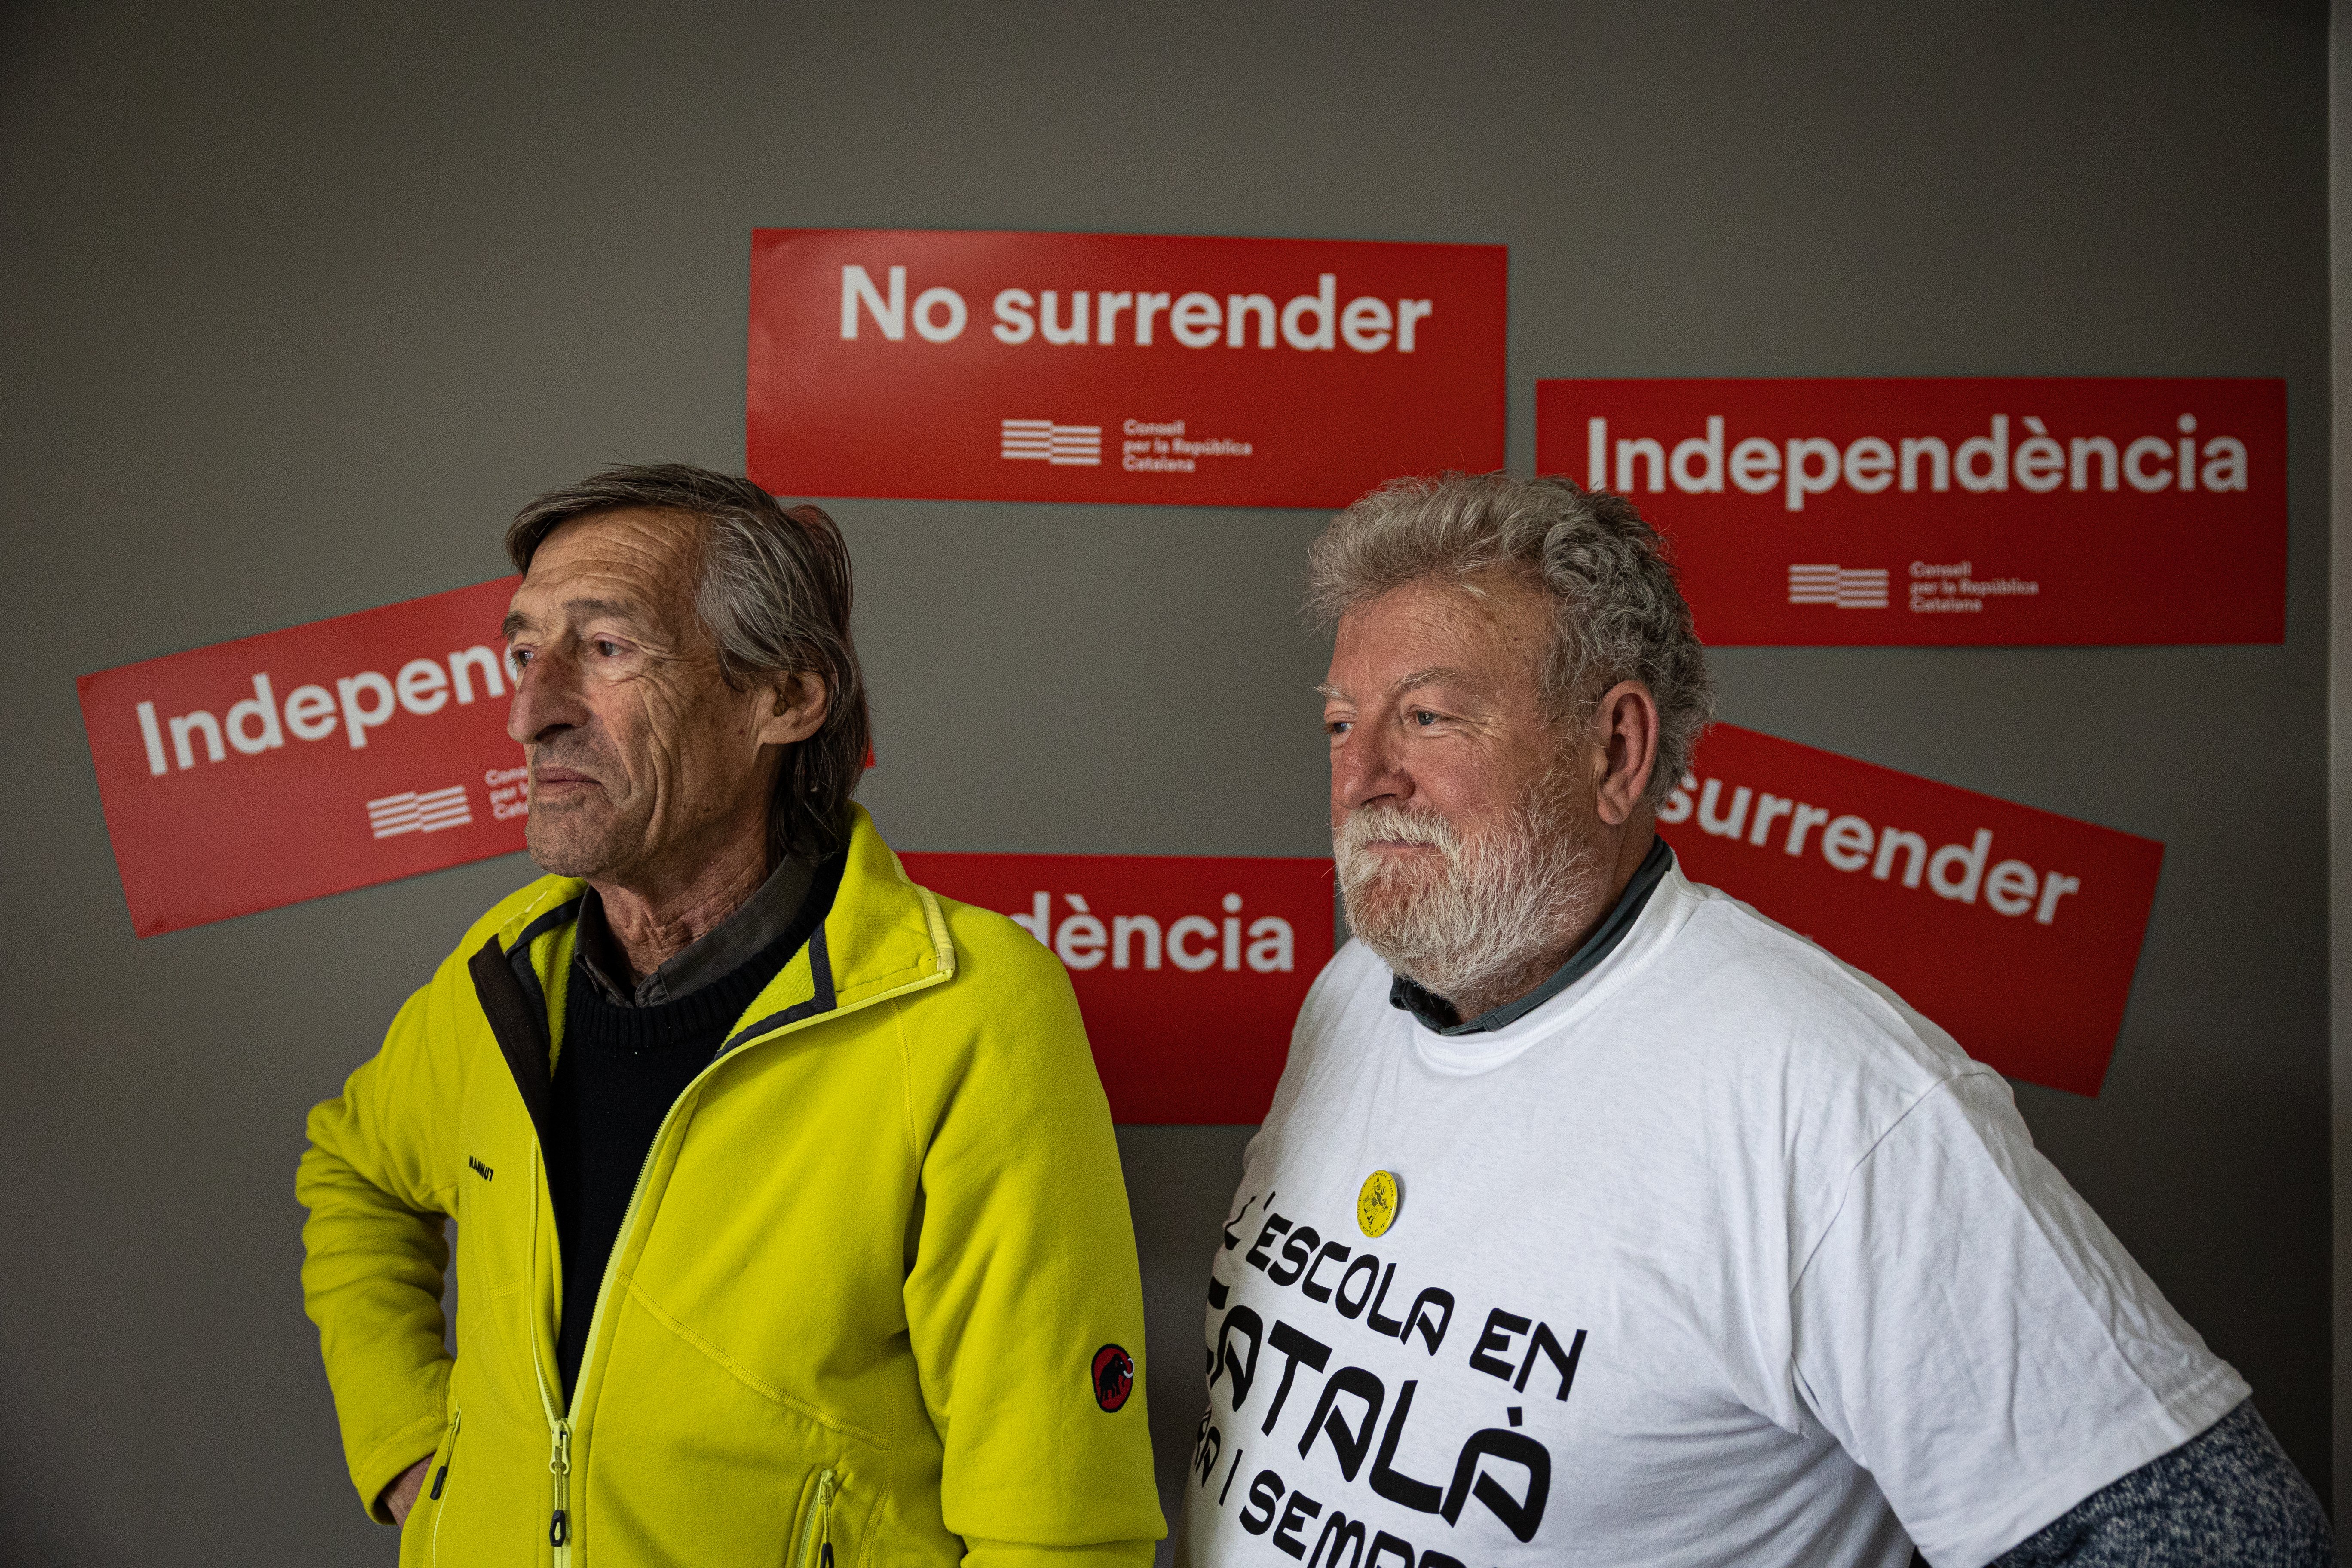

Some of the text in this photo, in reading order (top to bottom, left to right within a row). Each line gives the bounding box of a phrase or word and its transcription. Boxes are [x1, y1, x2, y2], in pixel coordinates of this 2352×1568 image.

[839, 264, 1433, 353] No surrender
[1123, 418, 1185, 437] Consell
[1123, 437, 1253, 458] per la República
[1122, 454, 1196, 472] Catalana
[1587, 414, 2248, 511] Independència
[1909, 560, 1972, 579] Consell
[1910, 578, 2040, 597] per la República
[1909, 596, 1983, 613] Catalana
[136, 644, 518, 775] Indepen
[1655, 773, 2081, 925] surrender
[1469, 1308, 1588, 1402] EN
[1219, 1448, 1243, 1507] I
